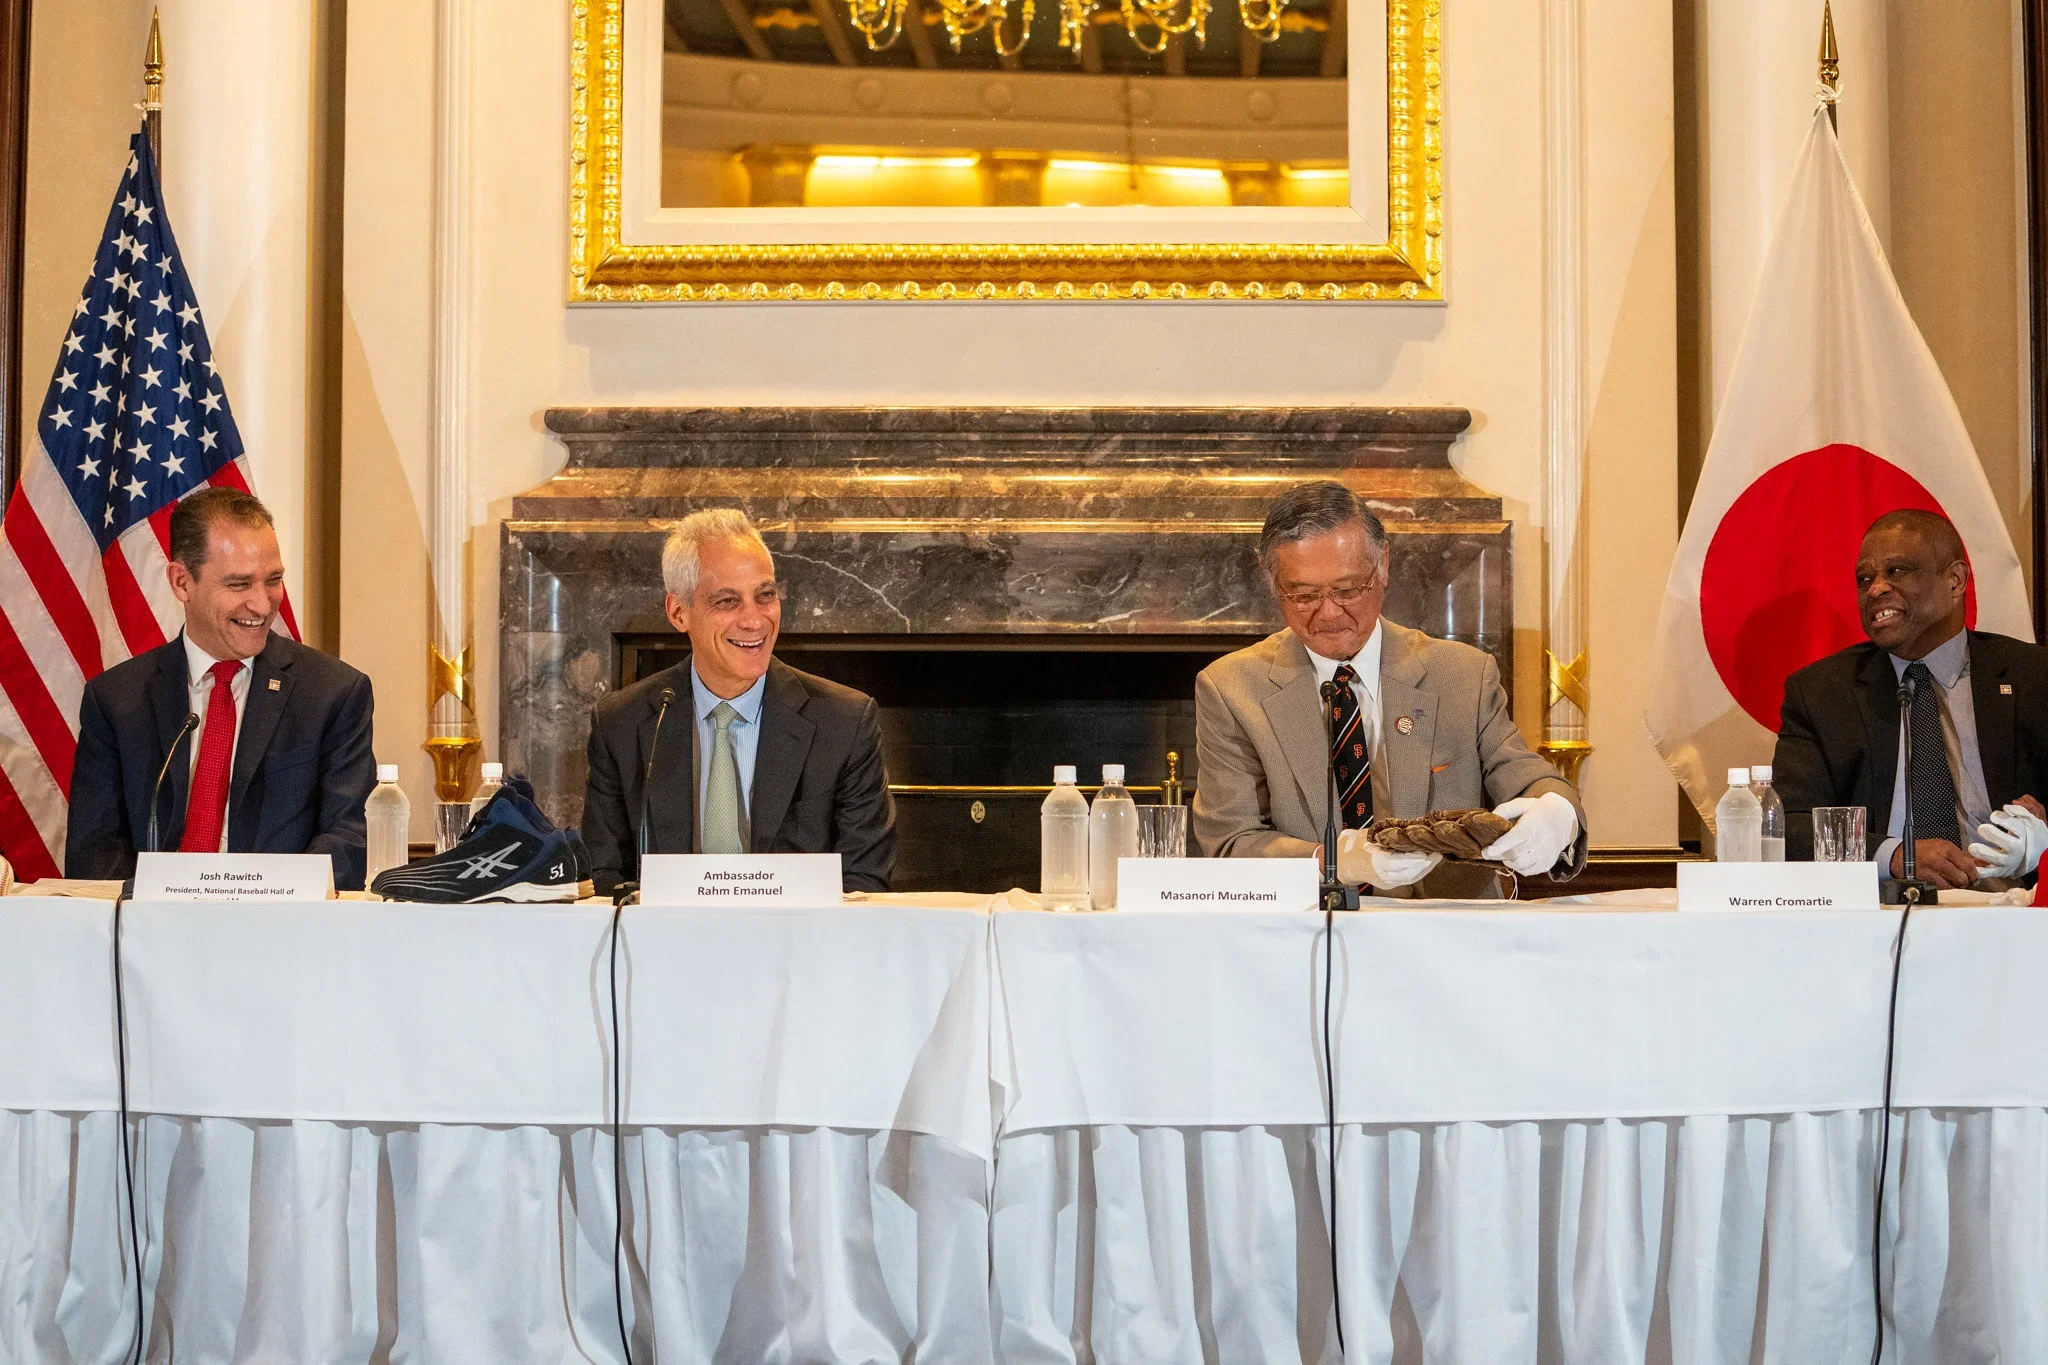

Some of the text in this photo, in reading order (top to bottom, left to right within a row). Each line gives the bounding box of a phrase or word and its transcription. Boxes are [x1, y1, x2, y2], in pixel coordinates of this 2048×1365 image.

[199, 872, 263, 881] Josh Rawitch
[549, 862, 565, 880] 51
[703, 870, 775, 881] Ambassador
[165, 886, 295, 896] President, National Baseball Hall of
[697, 885, 783, 896] Rahm Emanuel
[1160, 890, 1277, 901] Masanori Murakami
[1728, 896, 1833, 907] Warren Cromartie
